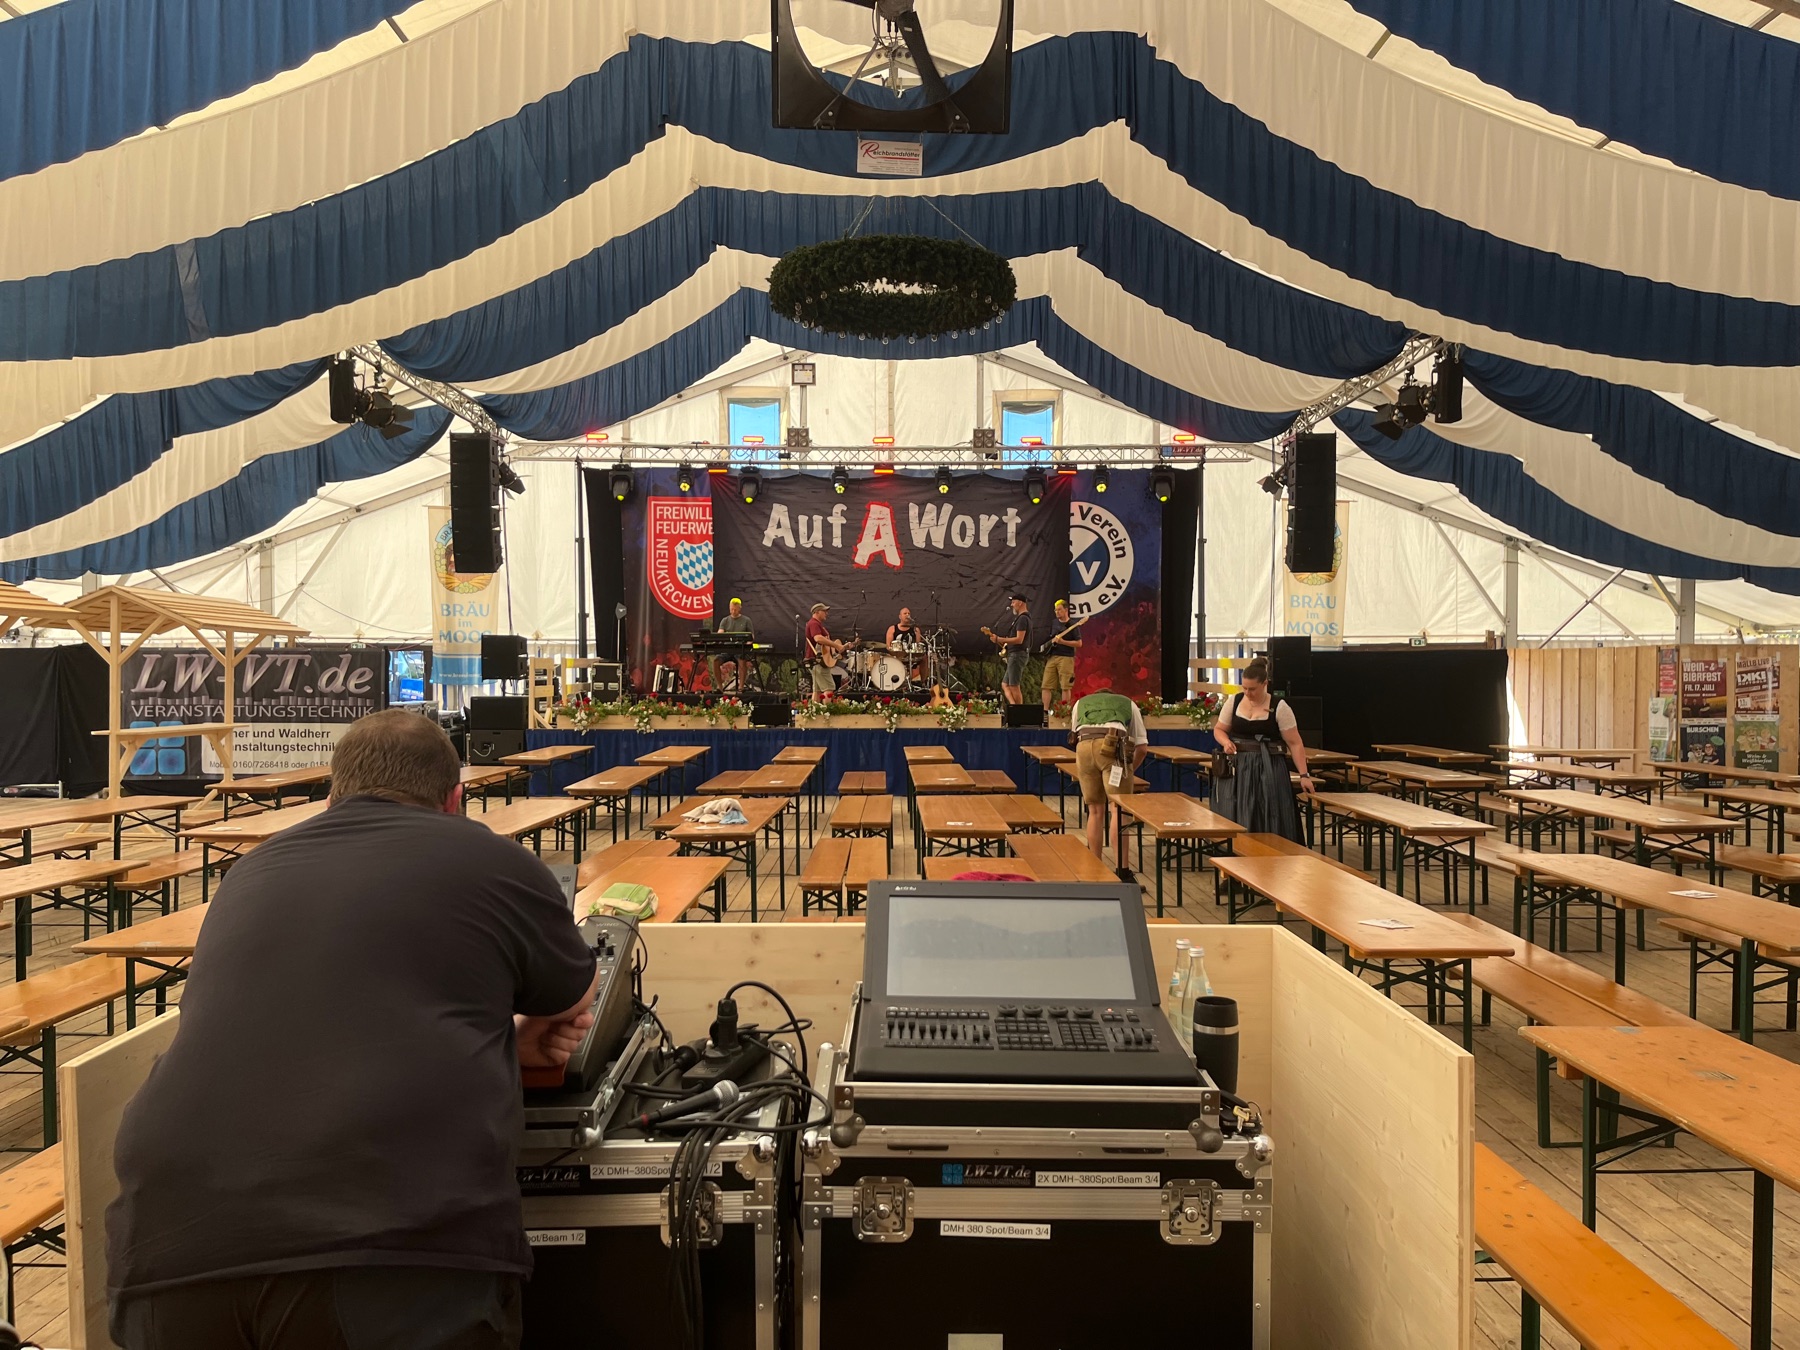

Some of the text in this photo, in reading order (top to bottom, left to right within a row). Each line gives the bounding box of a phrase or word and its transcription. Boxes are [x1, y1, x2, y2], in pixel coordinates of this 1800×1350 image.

[762, 501, 1022, 570] Auf A Wort
[656, 538, 713, 609] NEUKIRCHEN
[1290, 593, 1337, 609] BRÄU
[441, 601, 490, 617] BRÄU
[1306, 610, 1319, 619] im
[458, 618, 473, 628] im
[1286, 621, 1339, 636] MOOS
[130, 653, 374, 694] LW-VT.de
[131, 705, 374, 718] VERANSTATUNGSTECHNIK
[252, 728, 275, 738] und
[278, 728, 331, 738] Waldherr
[232, 760, 289, 769] 0160/7268418
[290, 760, 308, 768] oder
[592, 1167, 604, 1176] 2X
[964, 1164, 1031, 1178] LW-VT.de
[1037, 1175, 1049, 1183] 2X
[1052, 1175, 1142, 1185] DMH-380Spot/Beam
[1145, 1175, 1159, 1184] 3/4
[943, 1224, 1049, 1236] DMH 380 Spot/Beam 3/4
[571, 1232, 584, 1241] 1/2
